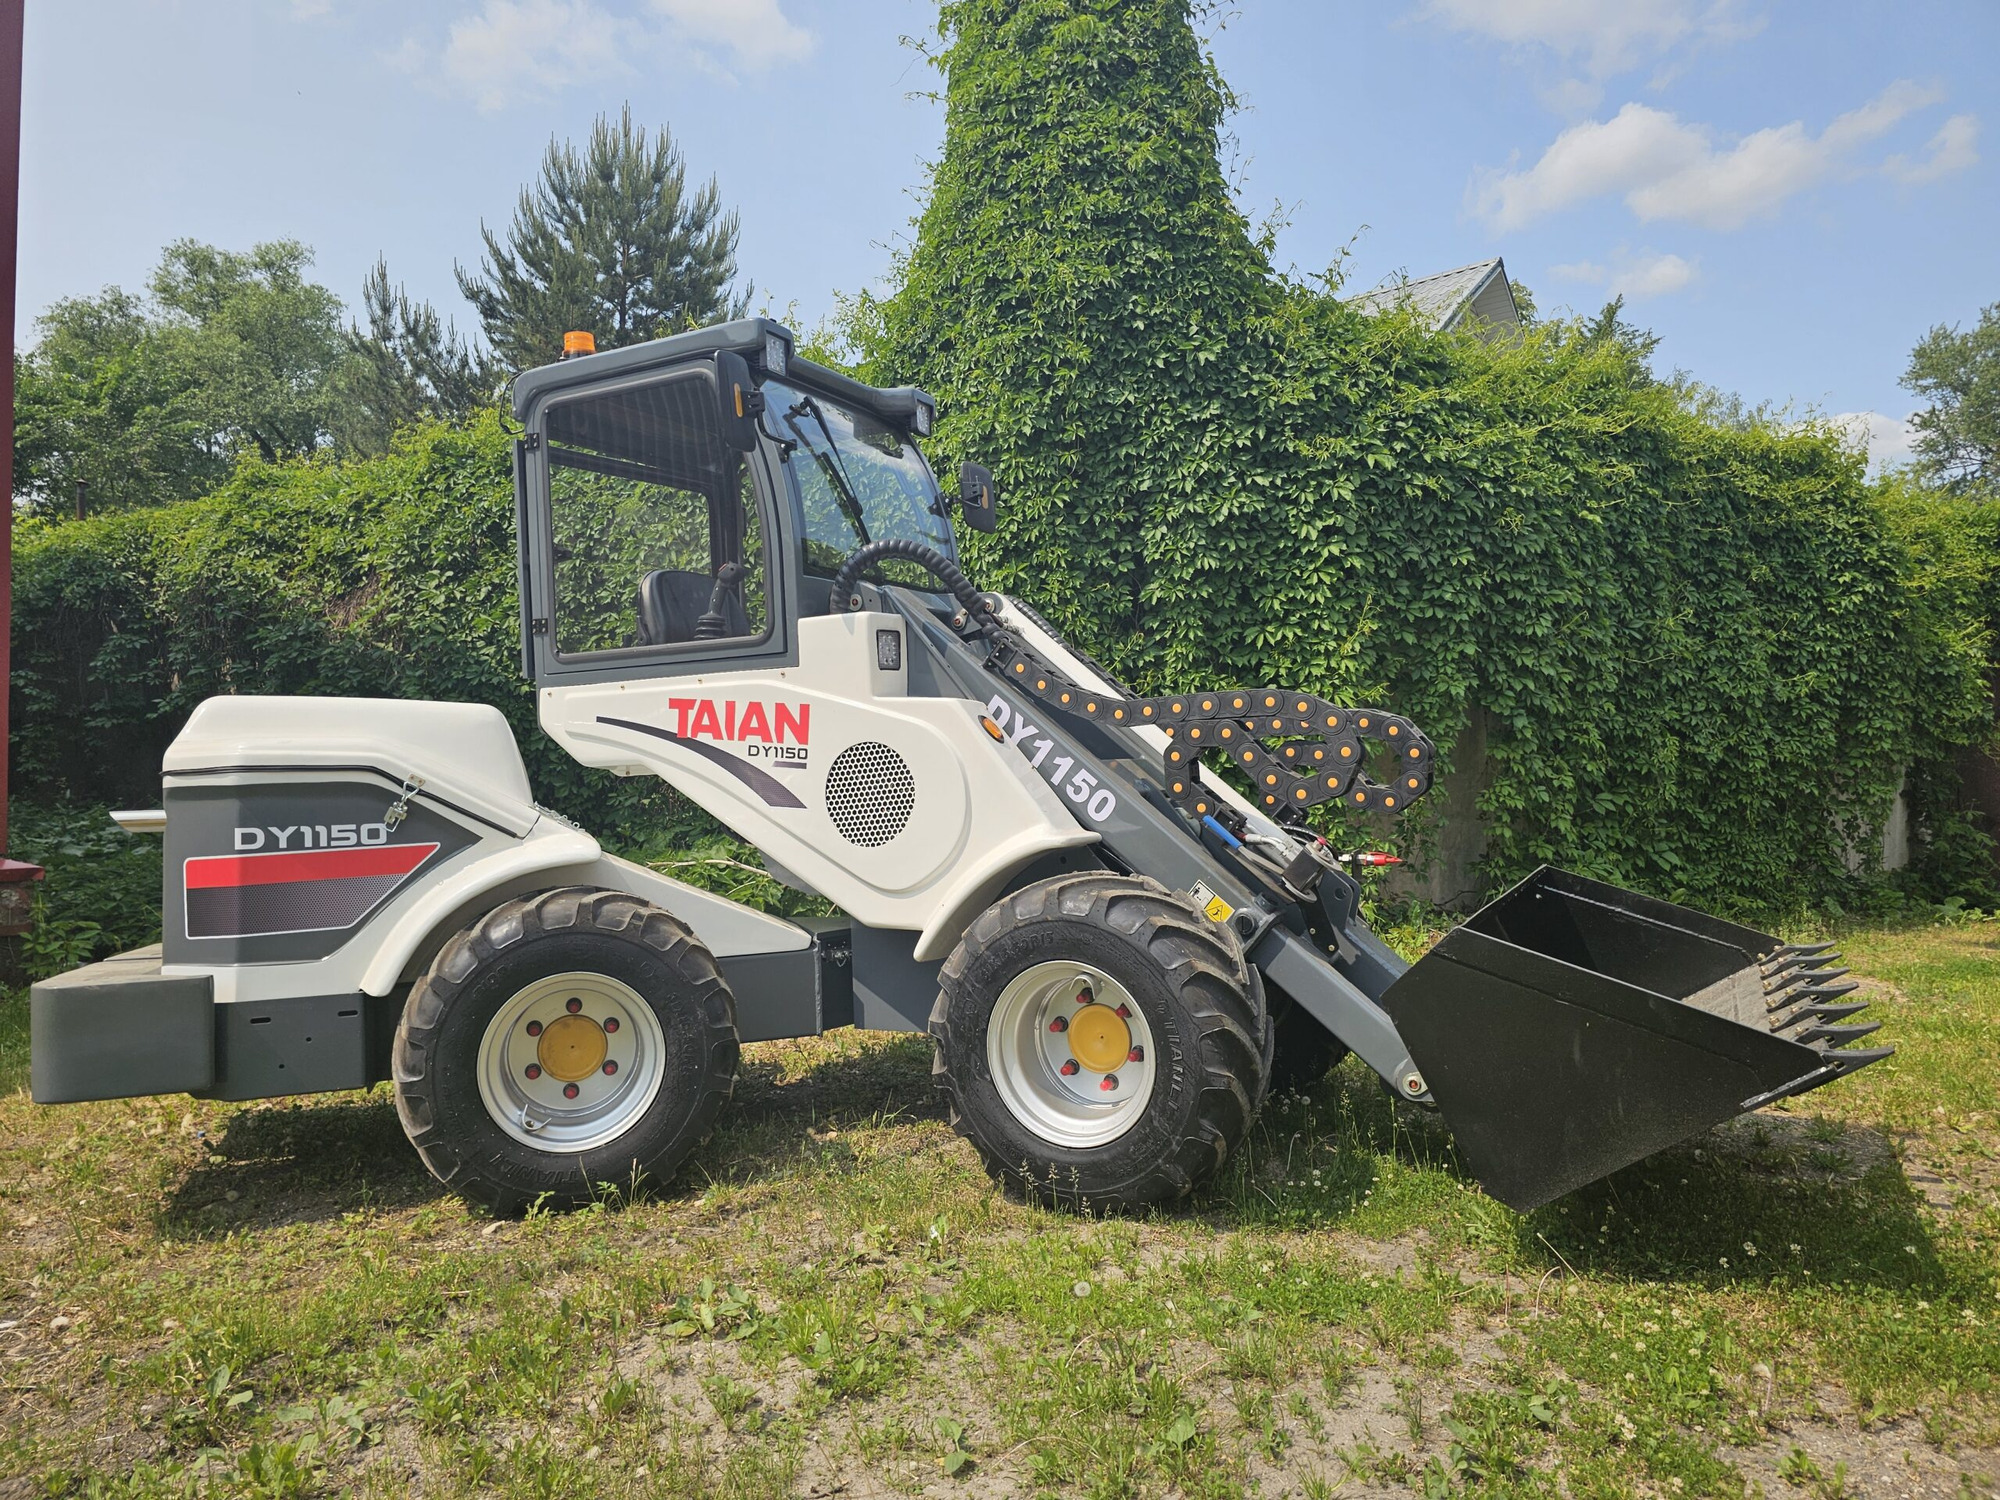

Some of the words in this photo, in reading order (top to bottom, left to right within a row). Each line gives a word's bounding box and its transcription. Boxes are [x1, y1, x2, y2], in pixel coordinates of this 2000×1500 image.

[668, 698, 811, 746] TAIAN
[747, 745, 808, 760] DY1150
[987, 694, 1117, 822] DY1150
[234, 823, 388, 850] DY1150
[1164, 1016, 1184, 1112] TIANLI
